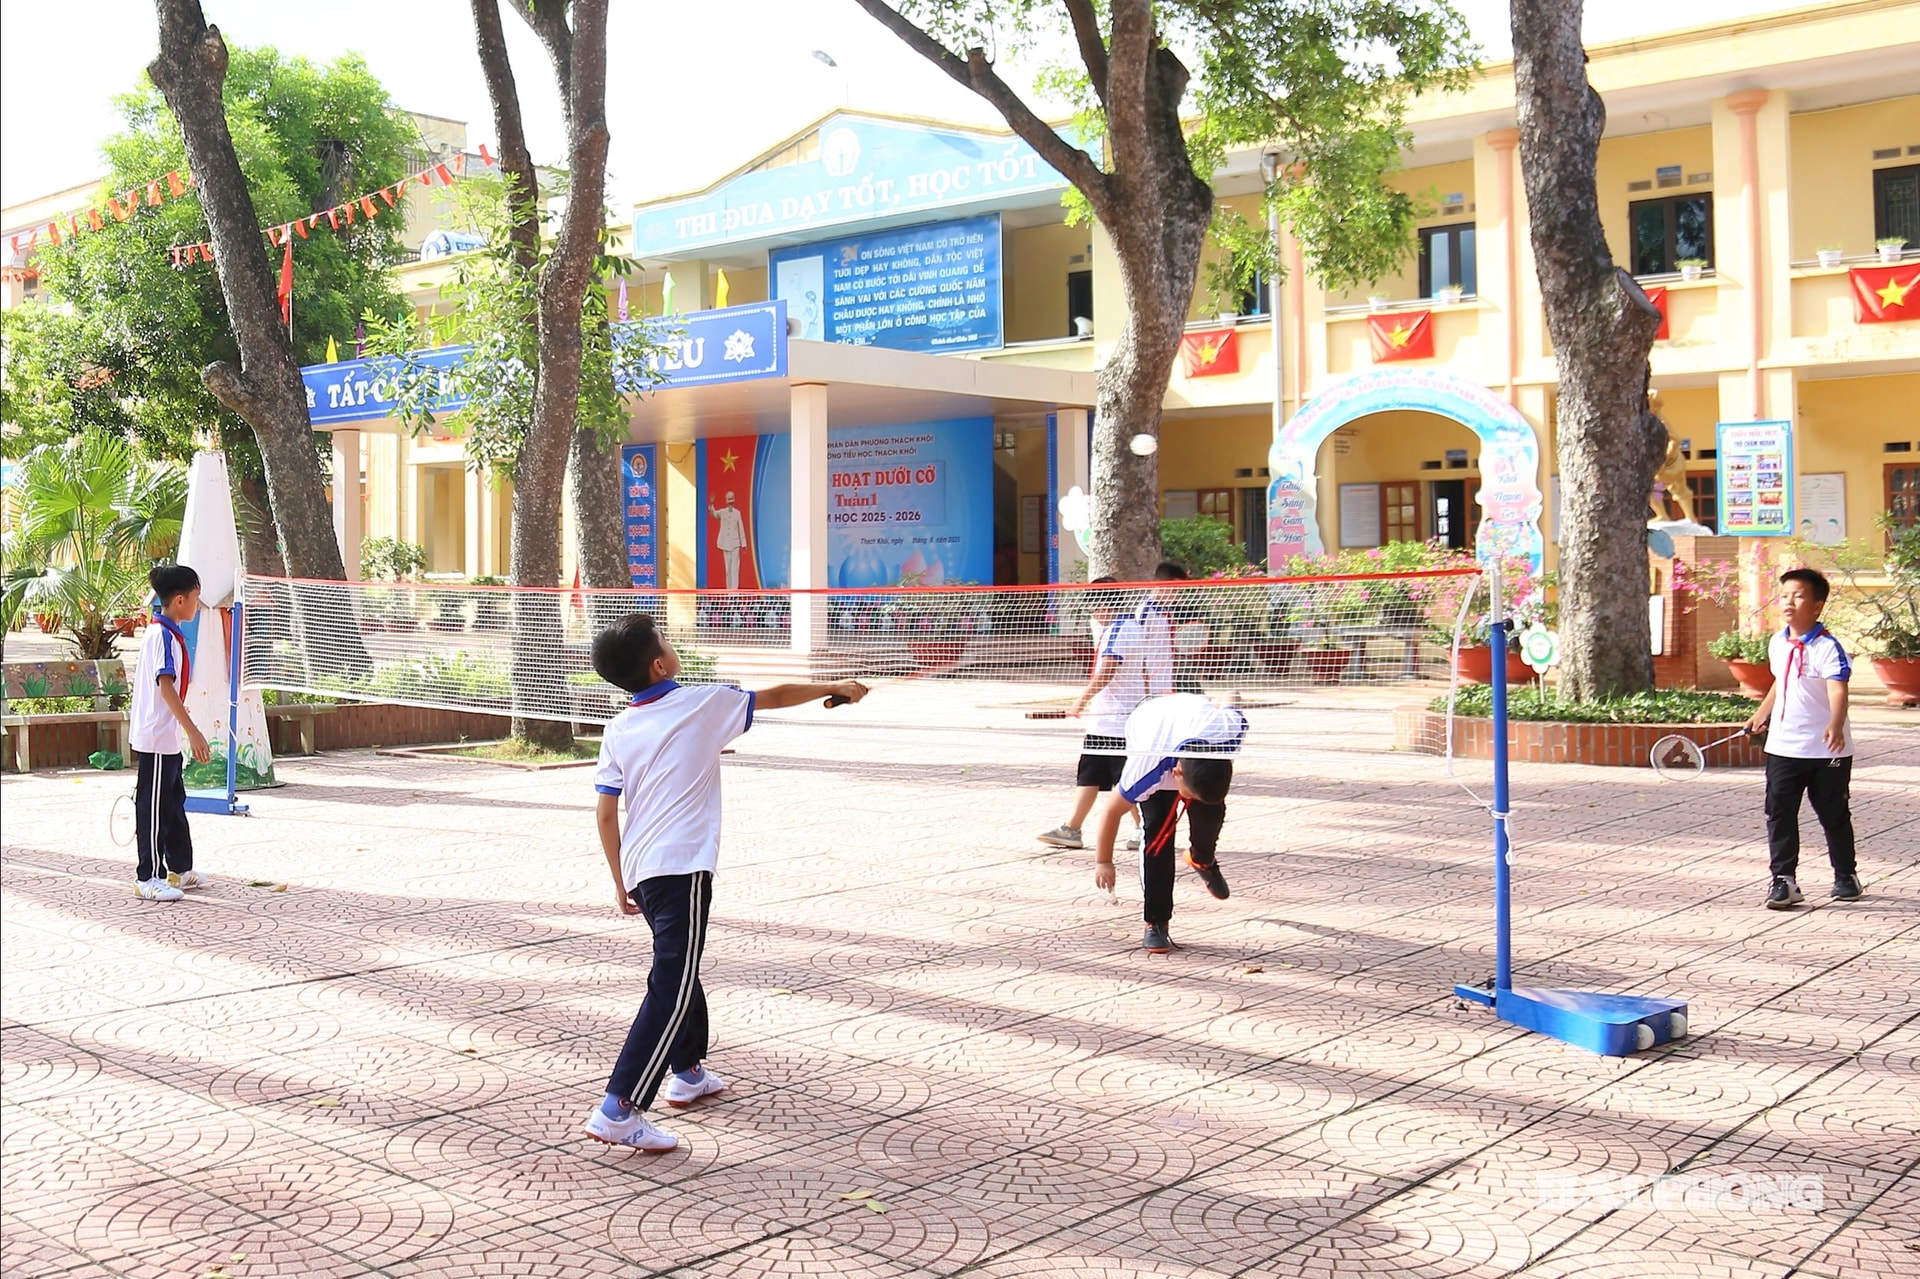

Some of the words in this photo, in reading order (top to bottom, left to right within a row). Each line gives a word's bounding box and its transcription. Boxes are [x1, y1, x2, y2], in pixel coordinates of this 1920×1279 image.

[675, 211, 717, 239] THI
[722, 203, 776, 231] ĐUA
[781, 189, 834, 222] DẠY
[838, 173, 899, 210] TỐT,
[908, 164, 971, 200] HỌC
[977, 144, 1040, 186] TỐT
[898, 243, 914, 256] VIỆT
[916, 241, 934, 252] NAM
[855, 265, 869, 276] ĐẸP
[873, 262, 889, 272] HAY
[925, 253, 942, 265] DÂN
[946, 251, 962, 263] TỘC
[967, 248, 984, 259] VIỆT
[834, 282, 851, 292] NAM
[853, 278, 863, 290] CÓ
[919, 269, 937, 281] VINH
[940, 266, 968, 278] QUANG
[834, 295, 855, 306] SÁNH
[858, 293, 871, 303] VAI
[890, 287, 906, 299] CÁC
[940, 278, 963, 292] QUỐC
[966, 277, 985, 289] NĂM
[834, 308, 854, 320] CHÂU
[879, 305, 894, 315] HAY
[929, 296, 952, 308] CHÍNH
[954, 293, 965, 305] LÀ
[905, 314, 926, 327] CÔNG
[930, 312, 947, 324] HỌC
[969, 305, 986, 319] CỦA
[328, 371, 370, 409] TẤT
[845, 439, 859, 448] DÂN
[858, 449, 873, 458] HỌC
[832, 471, 871, 491] HOẠT
[875, 466, 911, 486] DƯỚI
[915, 464, 936, 484] CỜ
[835, 491, 869, 507] Tuần
[871, 493, 878, 506] 1
[834, 513, 858, 525] HỌC
[861, 511, 886, 522] 2025
[895, 510, 921, 521] 2026
